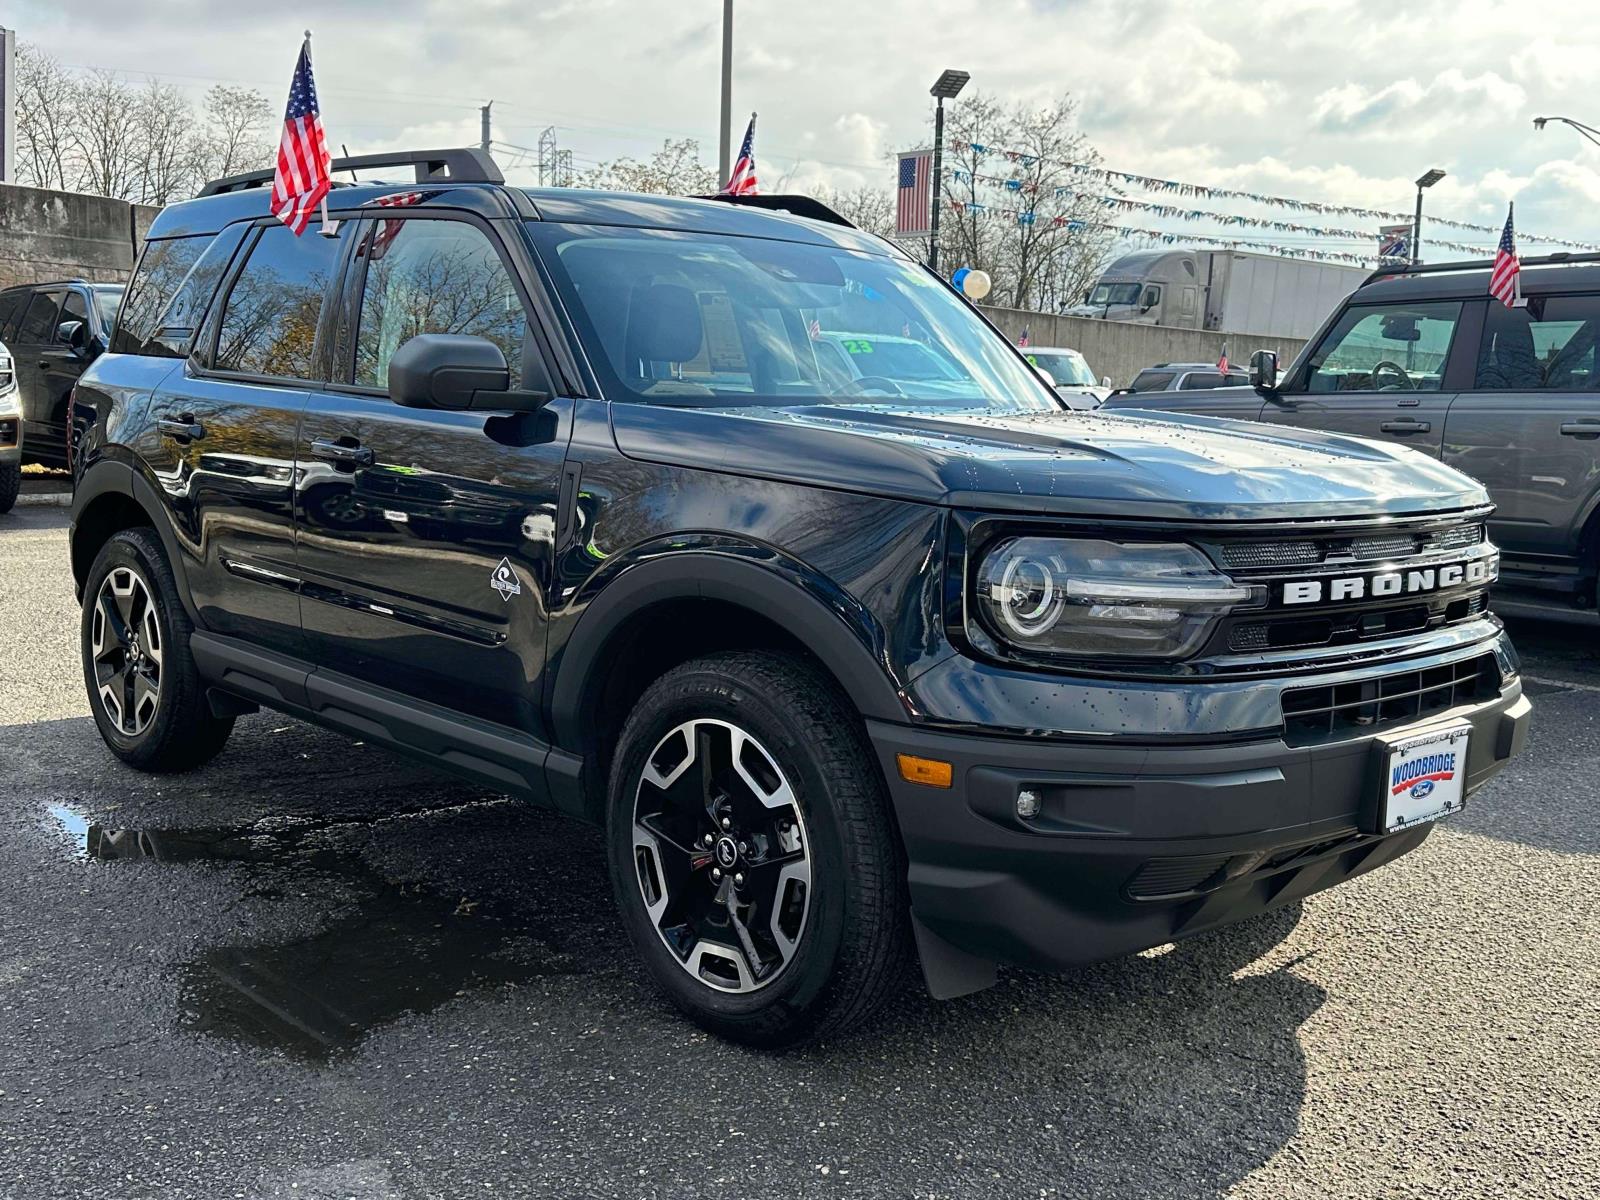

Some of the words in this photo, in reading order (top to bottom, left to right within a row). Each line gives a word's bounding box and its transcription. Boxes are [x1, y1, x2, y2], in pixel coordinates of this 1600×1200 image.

[842, 340, 874, 354] 23
[1283, 561, 1486, 605] BRONCO
[1392, 753, 1456, 787] WOODBRIDGE
